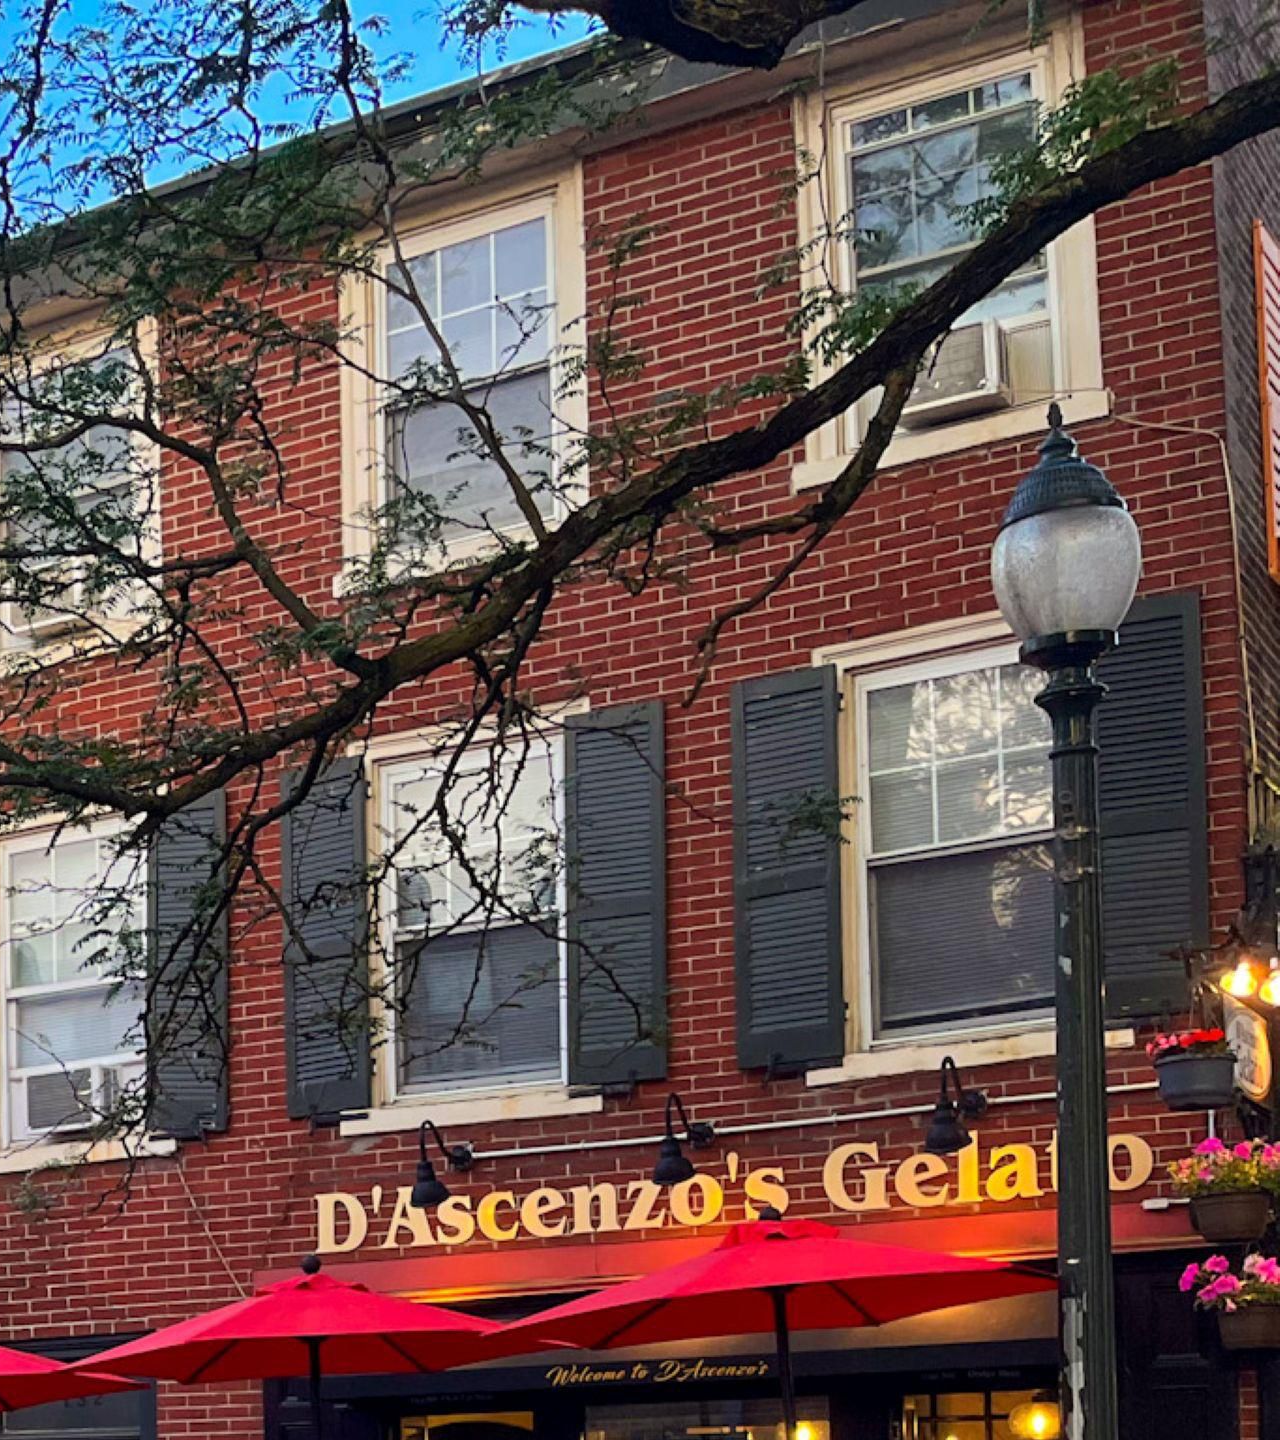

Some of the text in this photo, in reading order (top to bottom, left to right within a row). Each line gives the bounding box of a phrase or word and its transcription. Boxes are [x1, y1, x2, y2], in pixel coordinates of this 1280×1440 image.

[314, 1151, 790, 1254] D'Ascenzo's
[545, 1358, 769, 1387] Welcome to D'Ascenzo's
